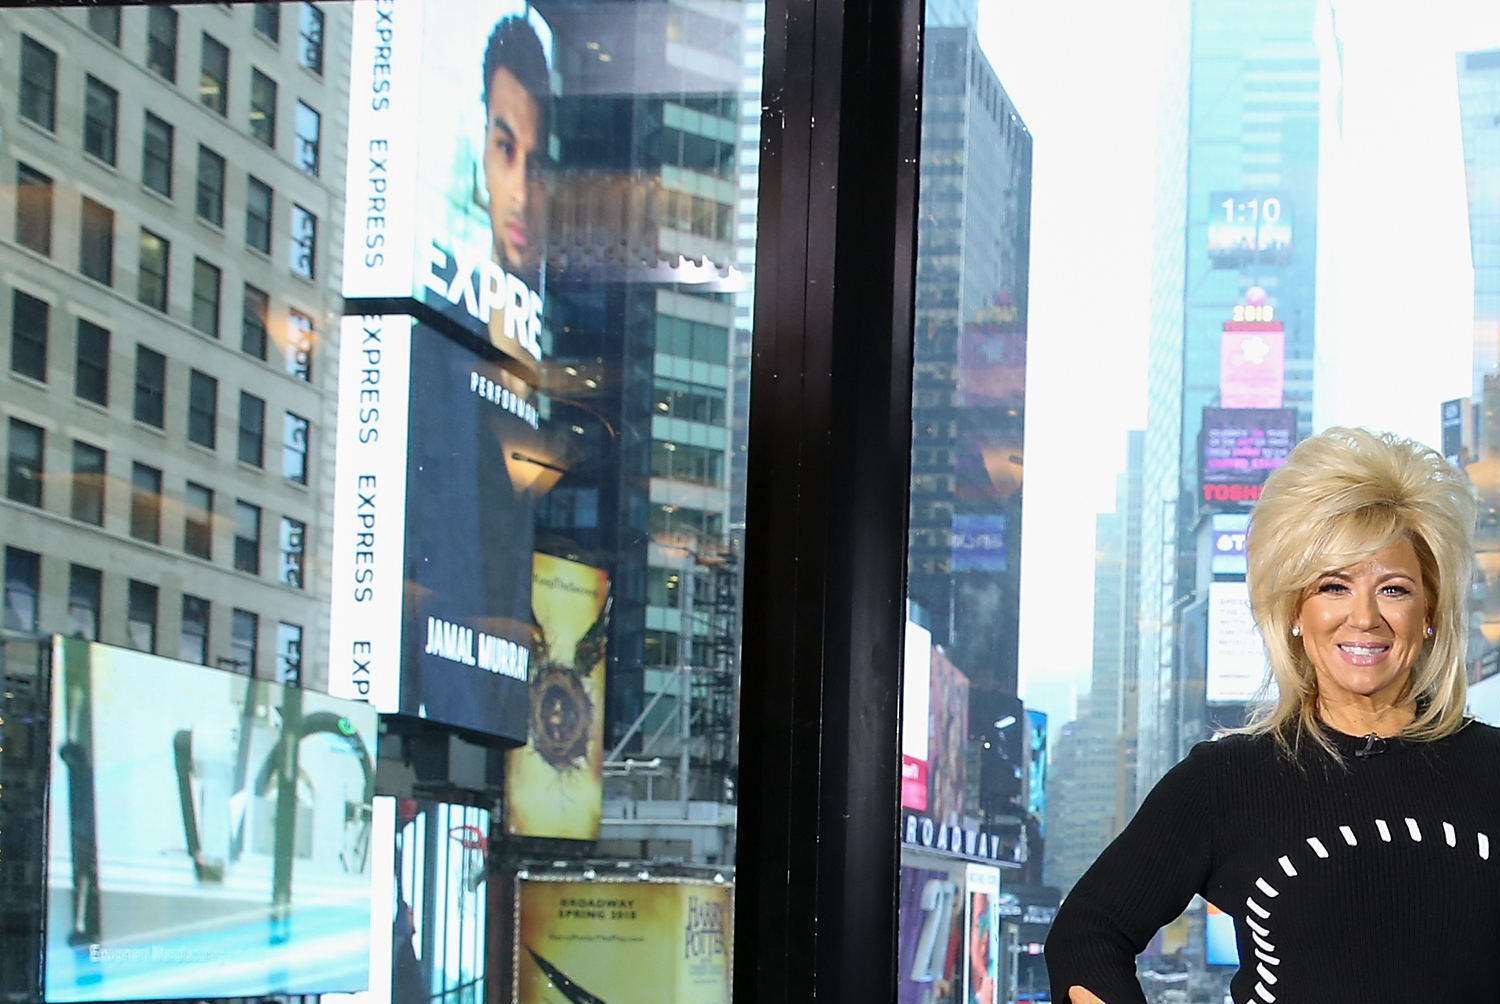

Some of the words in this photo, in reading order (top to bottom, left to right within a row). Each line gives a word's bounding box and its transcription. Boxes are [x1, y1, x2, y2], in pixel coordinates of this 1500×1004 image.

[365, 138, 388, 269] EXPRESS
[1222, 198, 1281, 223] 1:10
[354, 474, 376, 603] EXPRESS
[351, 640, 372, 701] EXP
[425, 616, 477, 667] JAMAL
[477, 632, 532, 682] MURRAY
[558, 909, 606, 919] SPRING
[560, 897, 635, 908] BROADWAY
